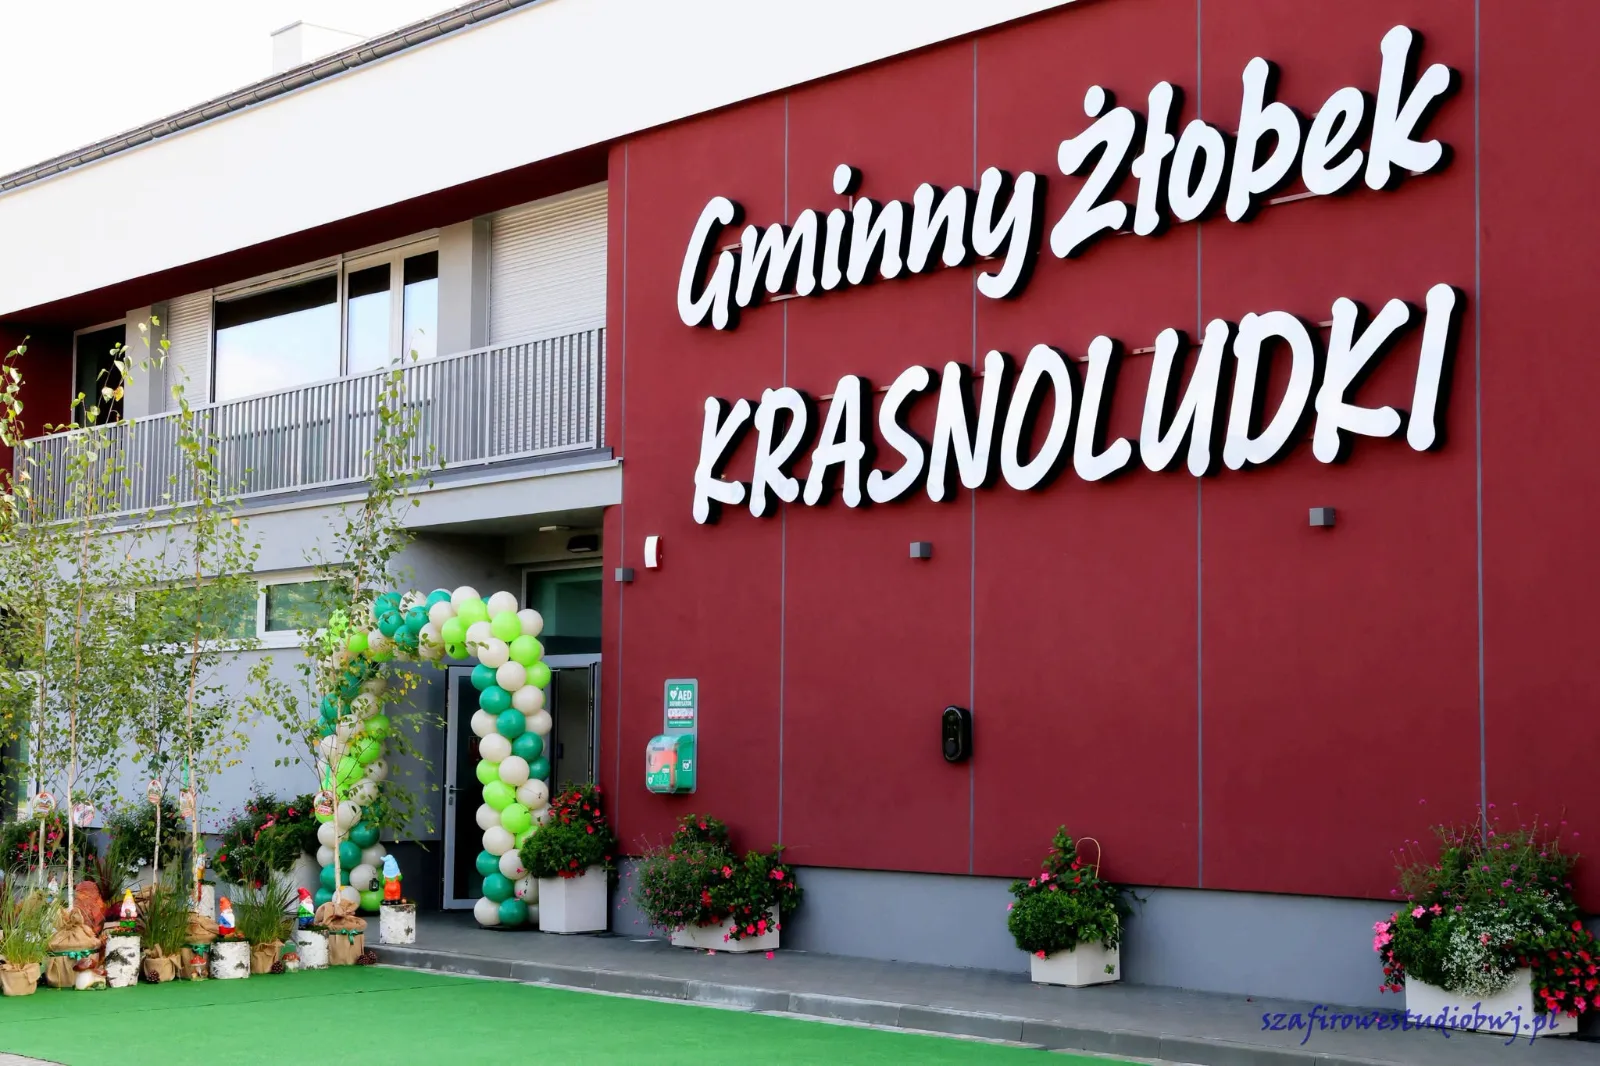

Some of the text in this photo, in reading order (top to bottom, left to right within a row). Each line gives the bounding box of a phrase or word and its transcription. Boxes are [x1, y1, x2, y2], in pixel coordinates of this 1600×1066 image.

[677, 24, 1453, 331] Gminny Żłobek
[692, 282, 1459, 526] KRASNOLUDKI
[677, 689, 693, 701] AED
